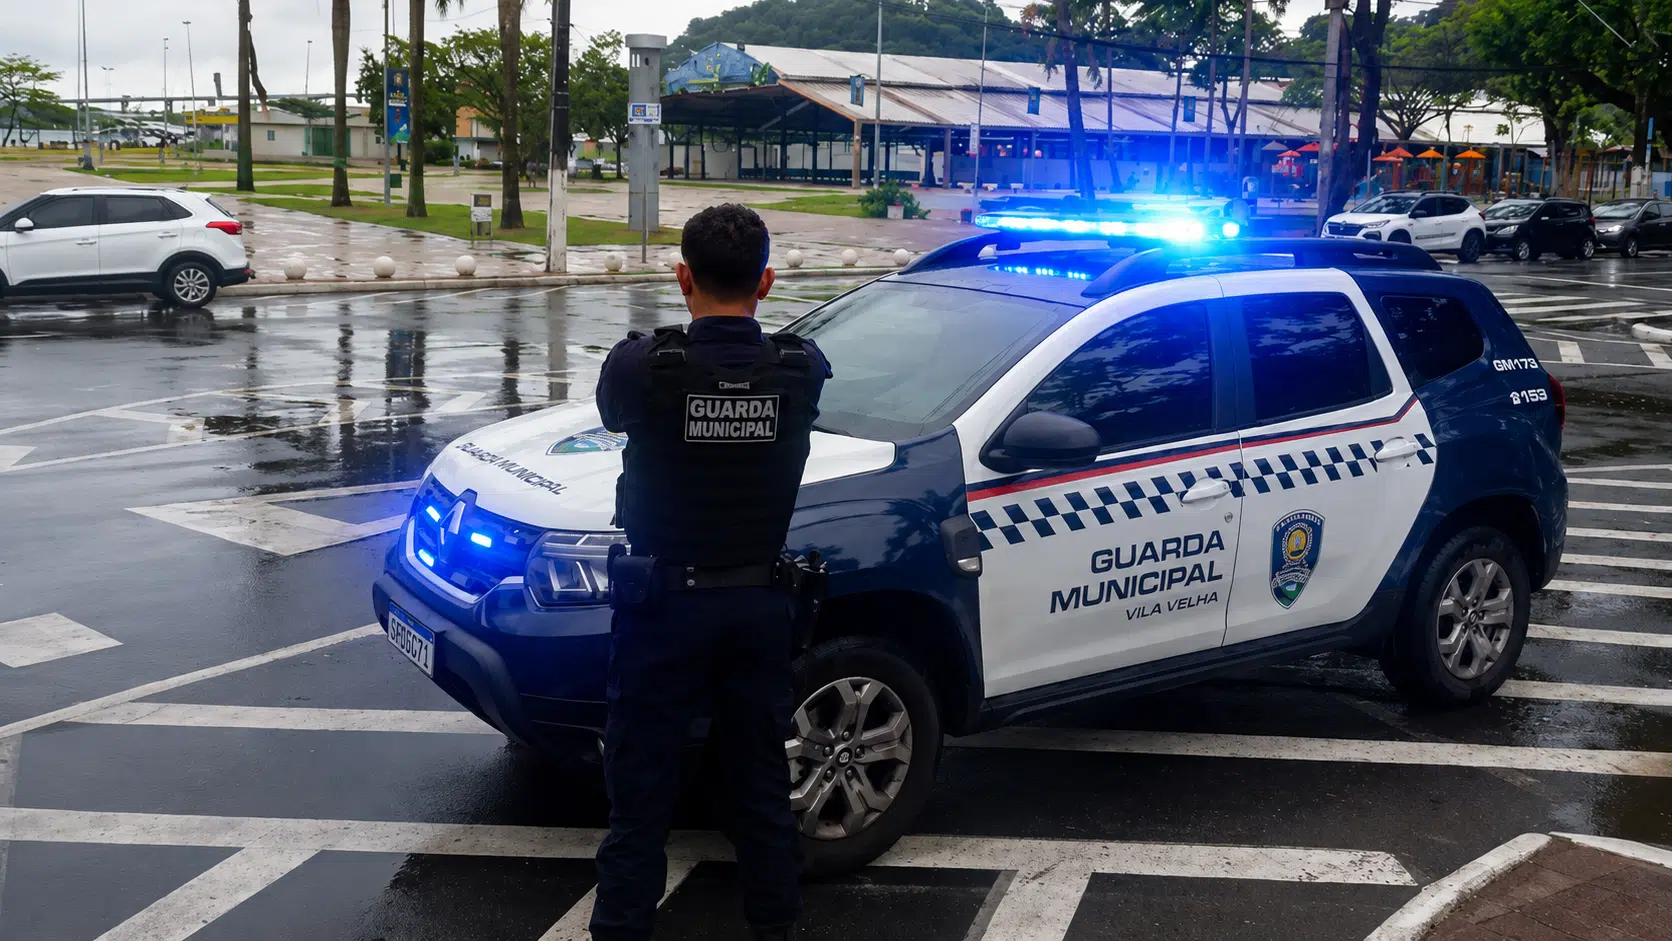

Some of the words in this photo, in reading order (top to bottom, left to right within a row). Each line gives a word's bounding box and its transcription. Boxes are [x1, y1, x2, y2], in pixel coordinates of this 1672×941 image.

[1493, 358, 1539, 371] GM173
[1520, 388, 1548, 403] 153
[690, 399, 775, 418] GUARDA
[688, 421, 773, 437] MUNICIPAL
[498, 459, 567, 495] MUNICIPAL
[1091, 530, 1225, 574] GUARDA
[1050, 560, 1223, 614] MUNICIPAL
[1126, 603, 1162, 620] VILA
[1167, 591, 1218, 612] VELHA
